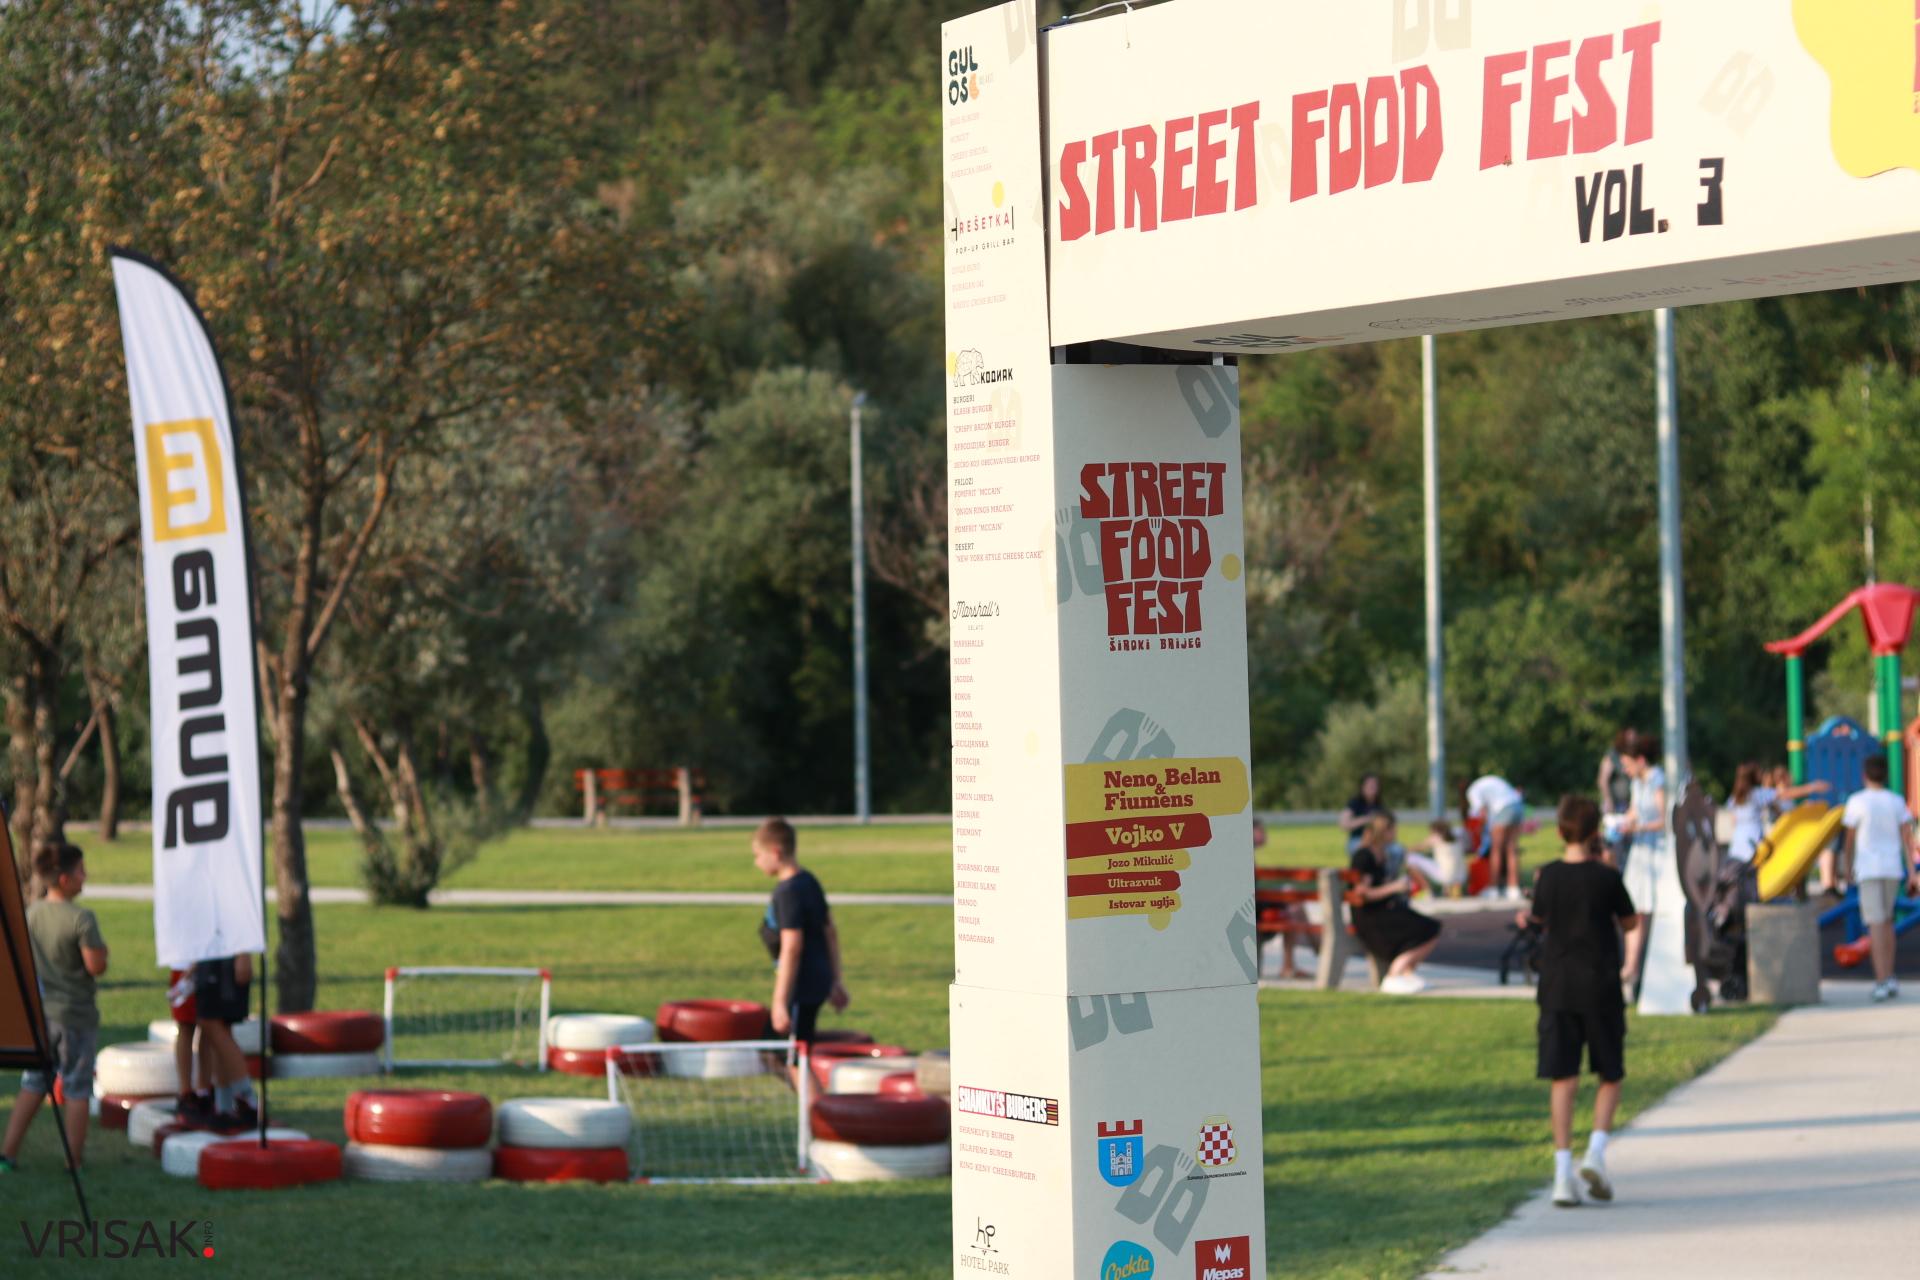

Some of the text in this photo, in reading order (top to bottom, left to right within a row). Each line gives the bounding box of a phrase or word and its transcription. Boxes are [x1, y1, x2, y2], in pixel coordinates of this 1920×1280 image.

[949, 45, 978, 76] GUL
[1058, 20, 1661, 241] STREET FOOD FEST
[1575, 158, 1724, 244] VOL. 3
[959, 212, 1010, 235] REŠETKA
[955, 237, 1015, 255] POP-UP GRILL BAR
[972, 404, 993, 414] BURGER
[995, 419, 1016, 429] BURGER
[988, 438, 1010, 448] BURGER
[1019, 454, 1041, 463] BURGER
[1079, 462, 1227, 518] STREET
[955, 542, 975, 551] DESERT
[1002, 551, 1025, 560] CHEESE
[1100, 517, 1211, 583] FOOD
[952, 600, 1000, 620] Marshall's
[1104, 580, 1203, 636] FEST
[1103, 767, 1221, 788] Neno Belan
[1154, 783, 1166, 795] &
[1104, 791, 1194, 811] Fiumens
[1105, 822, 1186, 849] Vojko V
[1107, 854, 1174, 870] Jozo Mikulić
[1107, 877, 1162, 889] Ultrazvuk
[1109, 899, 1146, 909] Istovar
[959, 1087, 1048, 1124] SHANKLY'S BURGERS
[959, 1125, 1015, 1142] SHANKLY'S BURGER
[989, 1148, 1013, 1159] BURGER
[960, 1253, 1010, 1276] HOTEL PARK
[1105, 1254, 1151, 1280] Cockta
[1202, 1267, 1244, 1280] Mepas
